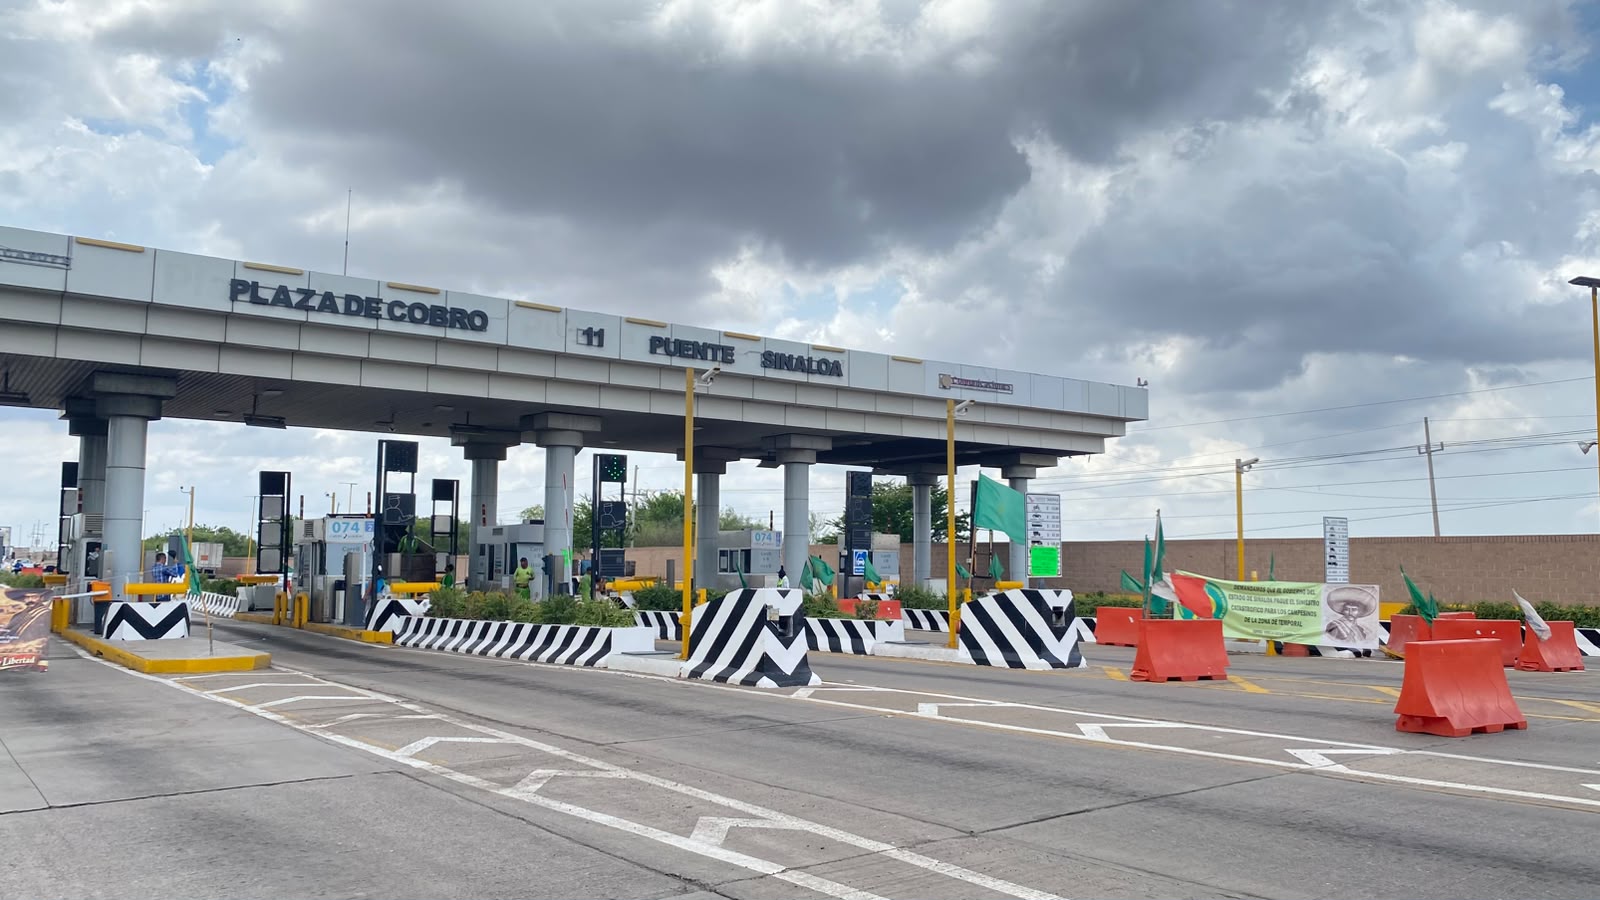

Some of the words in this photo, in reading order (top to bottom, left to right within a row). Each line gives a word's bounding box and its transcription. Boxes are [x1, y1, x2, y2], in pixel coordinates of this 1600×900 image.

[229, 278, 339, 314] PLAZA
[344, 294, 384, 319] DE
[387, 300, 490, 332] COBRO
[582, 327, 605, 348] 11
[649, 335, 735, 364] PUENTE
[761, 350, 844, 377] SINALOA
[332, 521, 360, 533] 074
[755, 532, 772, 542] 074
[1233, 585, 1265, 593] DEMANDAMOS
[1296, 599, 1320, 607] SINIESTRO
[1231, 605, 1264, 614] CATASTROFICO
[1287, 609, 1317, 617] CAMPESINOS
